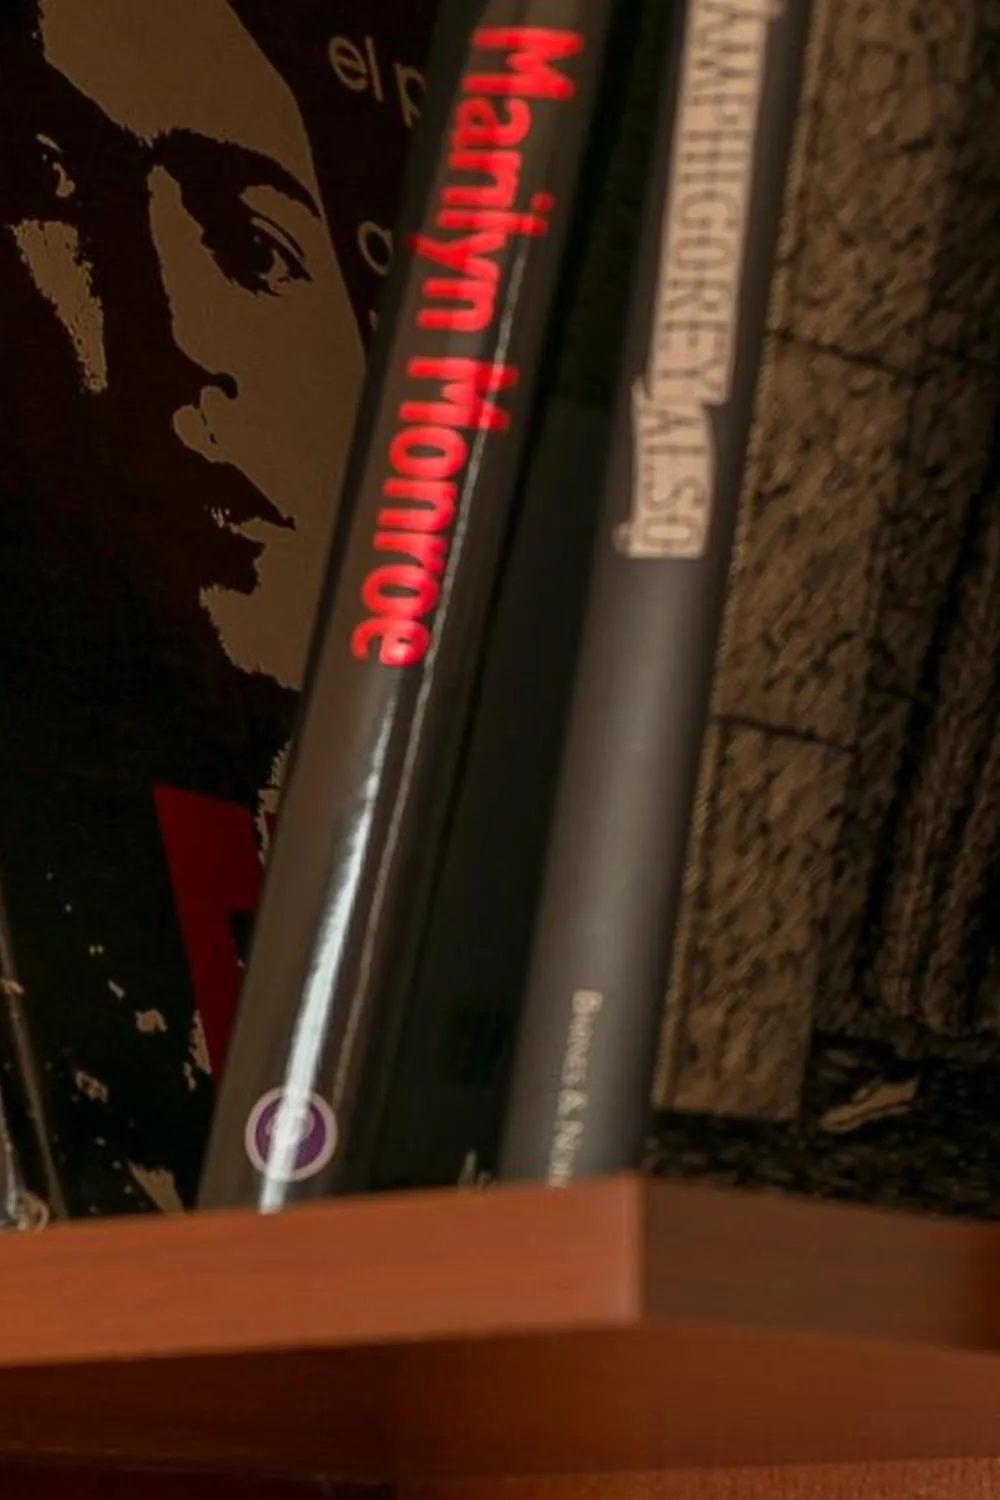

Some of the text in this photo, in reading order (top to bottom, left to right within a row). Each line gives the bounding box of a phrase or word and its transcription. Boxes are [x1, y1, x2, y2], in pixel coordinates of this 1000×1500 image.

[329, 36, 385, 102] el
[351, 25, 583, 668] Marilyn Monroe
[640, 400, 706, 554] ALSO
